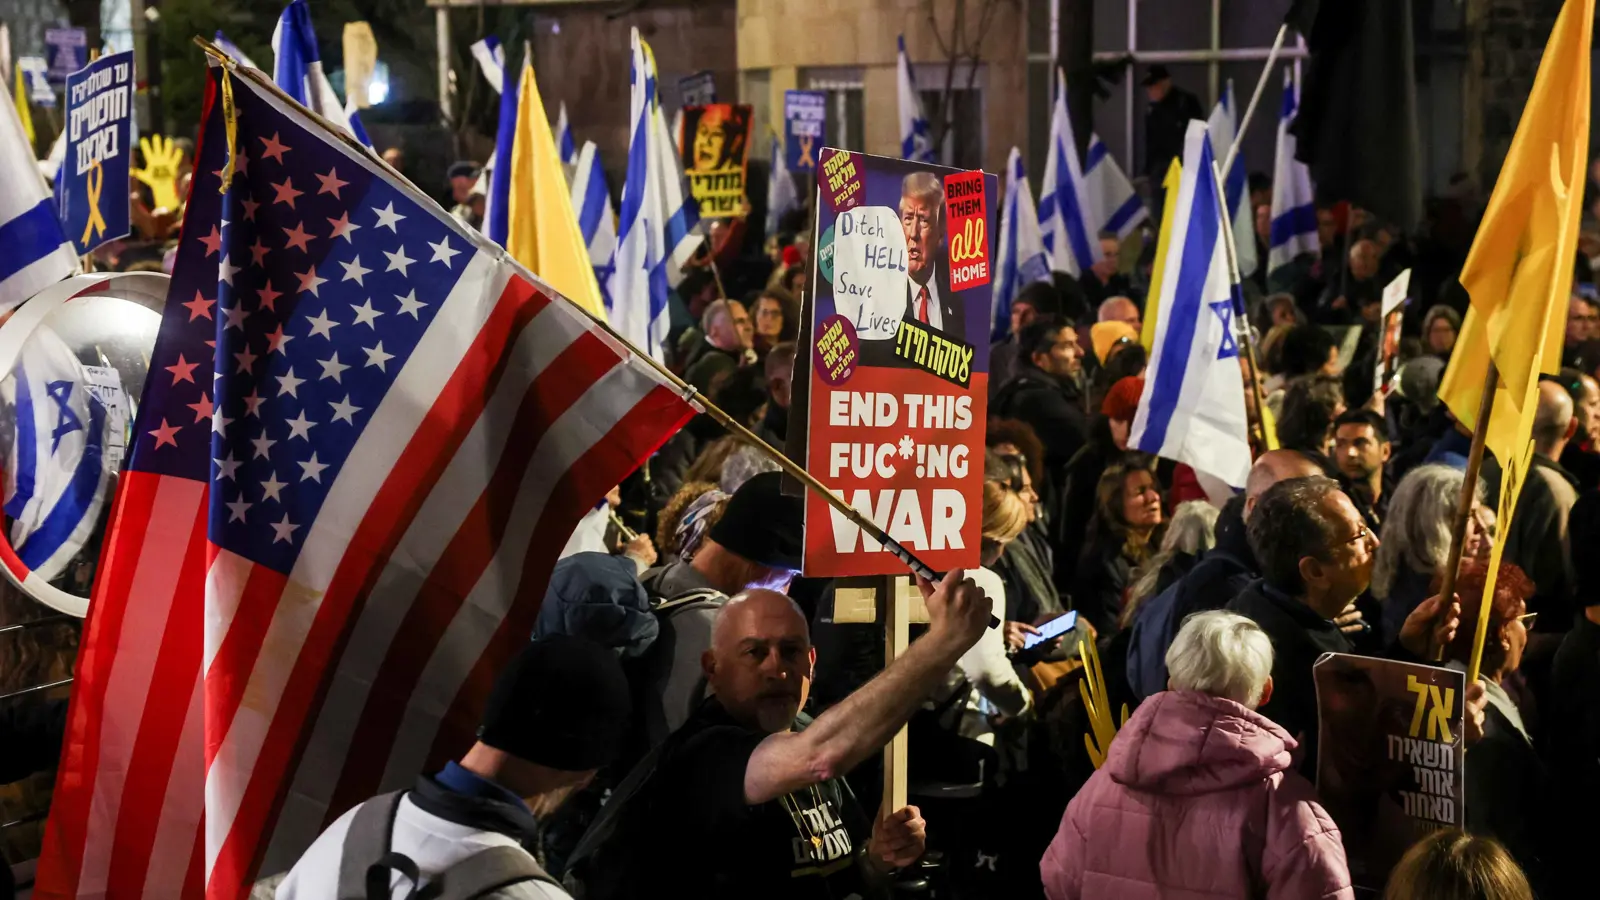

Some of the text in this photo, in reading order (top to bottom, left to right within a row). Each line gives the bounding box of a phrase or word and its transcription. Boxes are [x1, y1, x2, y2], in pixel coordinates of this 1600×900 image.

[114, 62, 129, 84] עד
[70, 86, 128, 143] חופשיים
[822, 150, 851, 177] עסקה
[828, 162, 857, 193] מלאה
[693, 172, 741, 191] מחרי
[947, 178, 983, 199] BRING
[841, 212, 884, 239] Ditch
[949, 200, 981, 219] THEM
[951, 217, 985, 263] all
[864, 243, 907, 272] HELL
[952, 262, 987, 284] HOME
[838, 271, 873, 299] Save
[855, 303, 897, 336] Lives
[816, 319, 843, 355] עסקה
[823, 333, 851, 369] מלאה
[895, 320, 973, 383] עסקה מיד!
[829, 390, 973, 430] END THIS
[828, 488, 967, 554] WAR
[1407, 674, 1455, 743] אל
[1387, 734, 1454, 771] תשאירו
[1412, 766, 1455, 798] אותי
[1398, 790, 1455, 824] מאחור
